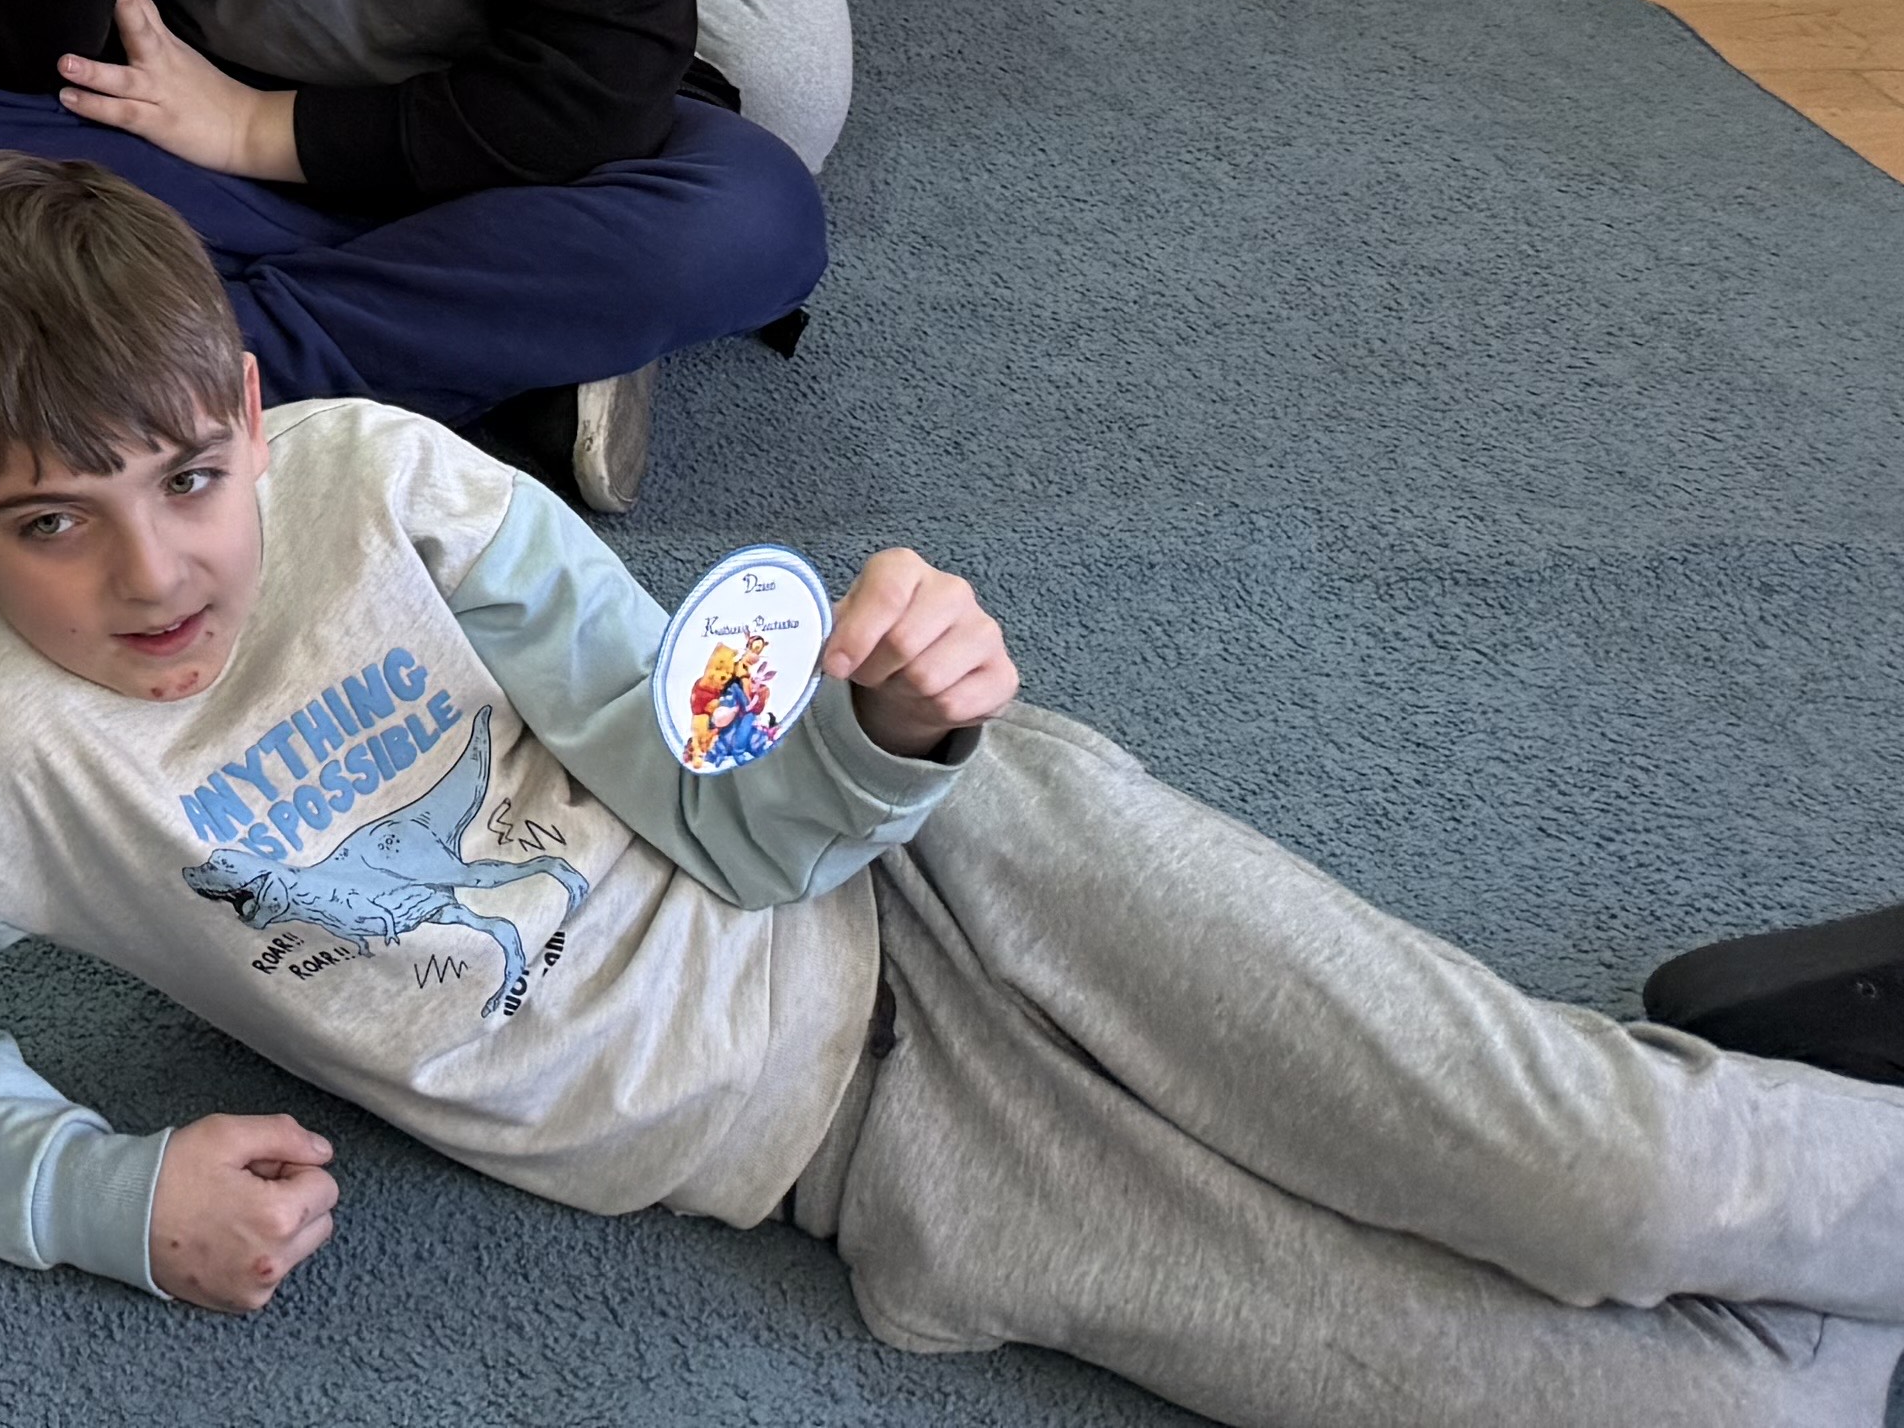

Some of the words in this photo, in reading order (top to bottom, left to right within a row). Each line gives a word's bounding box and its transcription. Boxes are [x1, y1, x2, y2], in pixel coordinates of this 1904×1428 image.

[179, 648, 429, 842] ANYTHING
[269, 690, 464, 852] POSSIBLE
[252, 931, 304, 975] ROAR!!
[288, 946, 355, 981] ROAR!!
